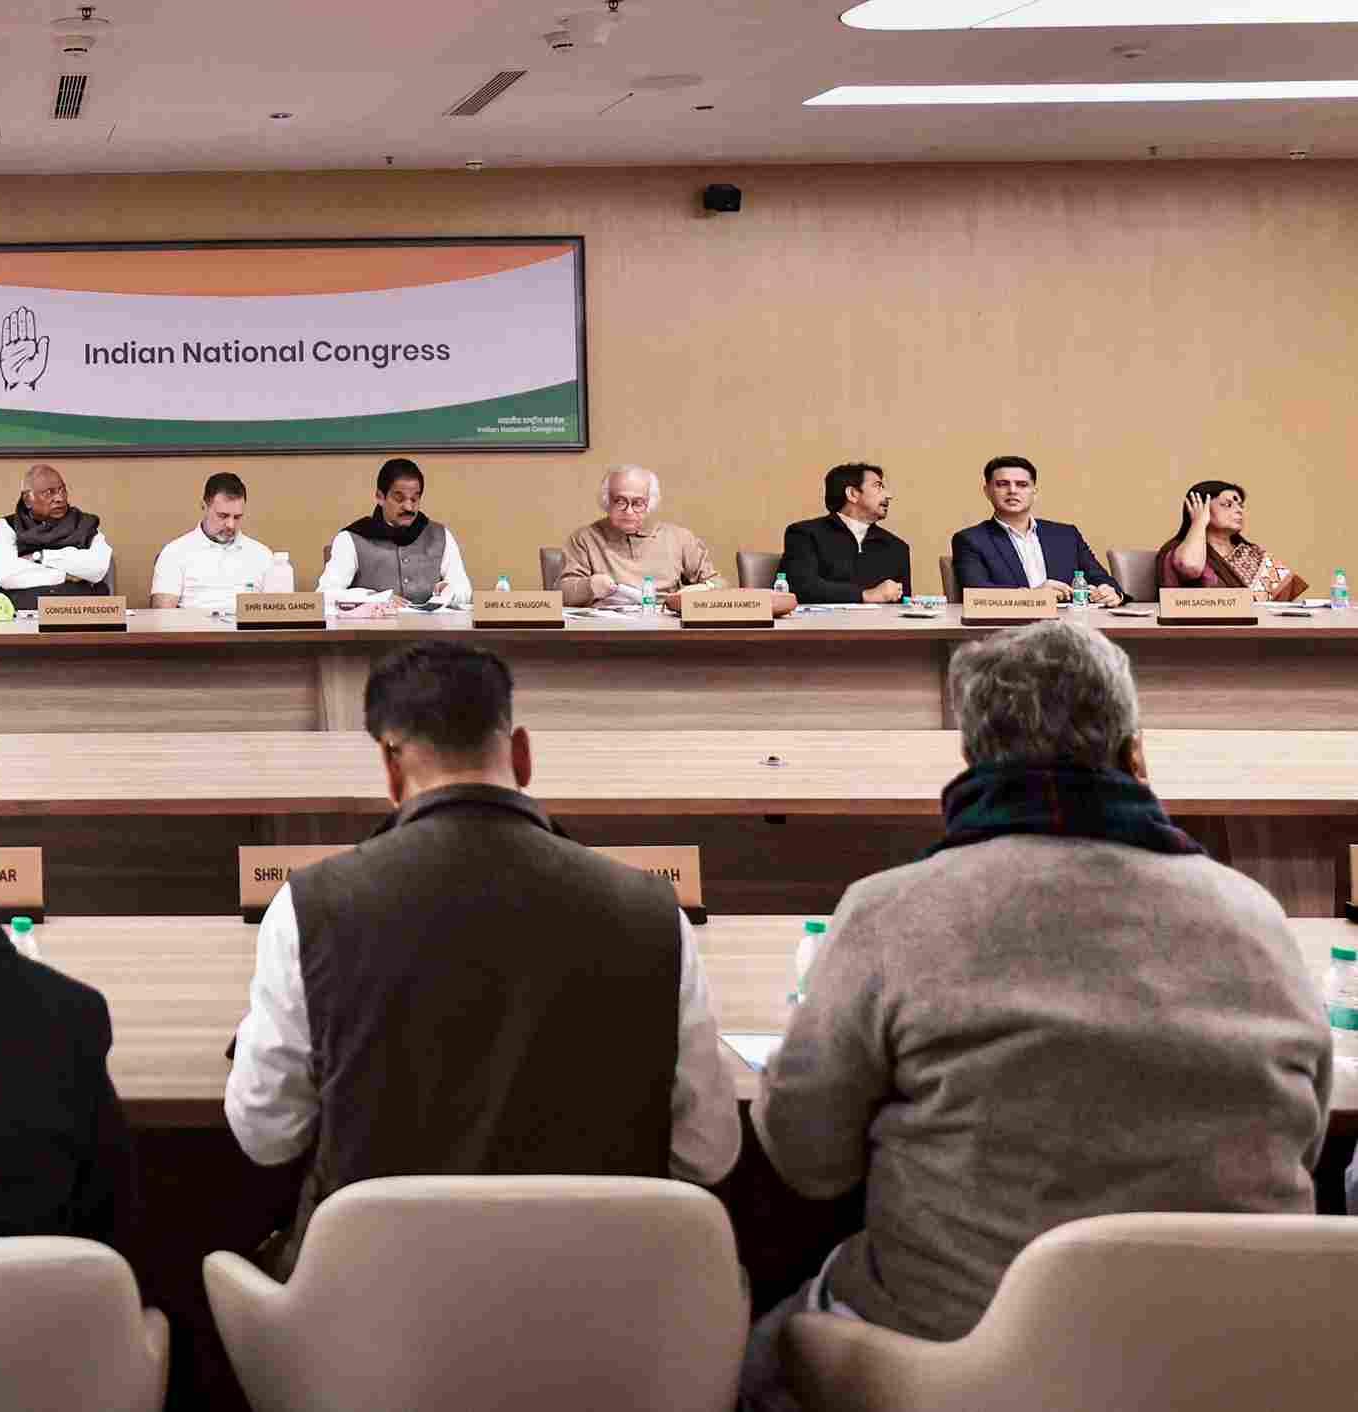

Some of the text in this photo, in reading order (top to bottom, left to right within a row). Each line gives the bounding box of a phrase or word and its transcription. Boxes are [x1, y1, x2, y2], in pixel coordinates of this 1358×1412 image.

[84, 340, 451, 369] Indian National Congress
[244, 602, 315, 612] SHRI RAHUL GANDHI
[483, 600, 499, 609] SHRI
[692, 601, 707, 609] SHRI
[1175, 598, 1237, 607] SHRI SACHIN PILOT
[45, 606, 120, 615] CONGRESS PRESIDENT
[254, 867, 283, 882] SHRI
